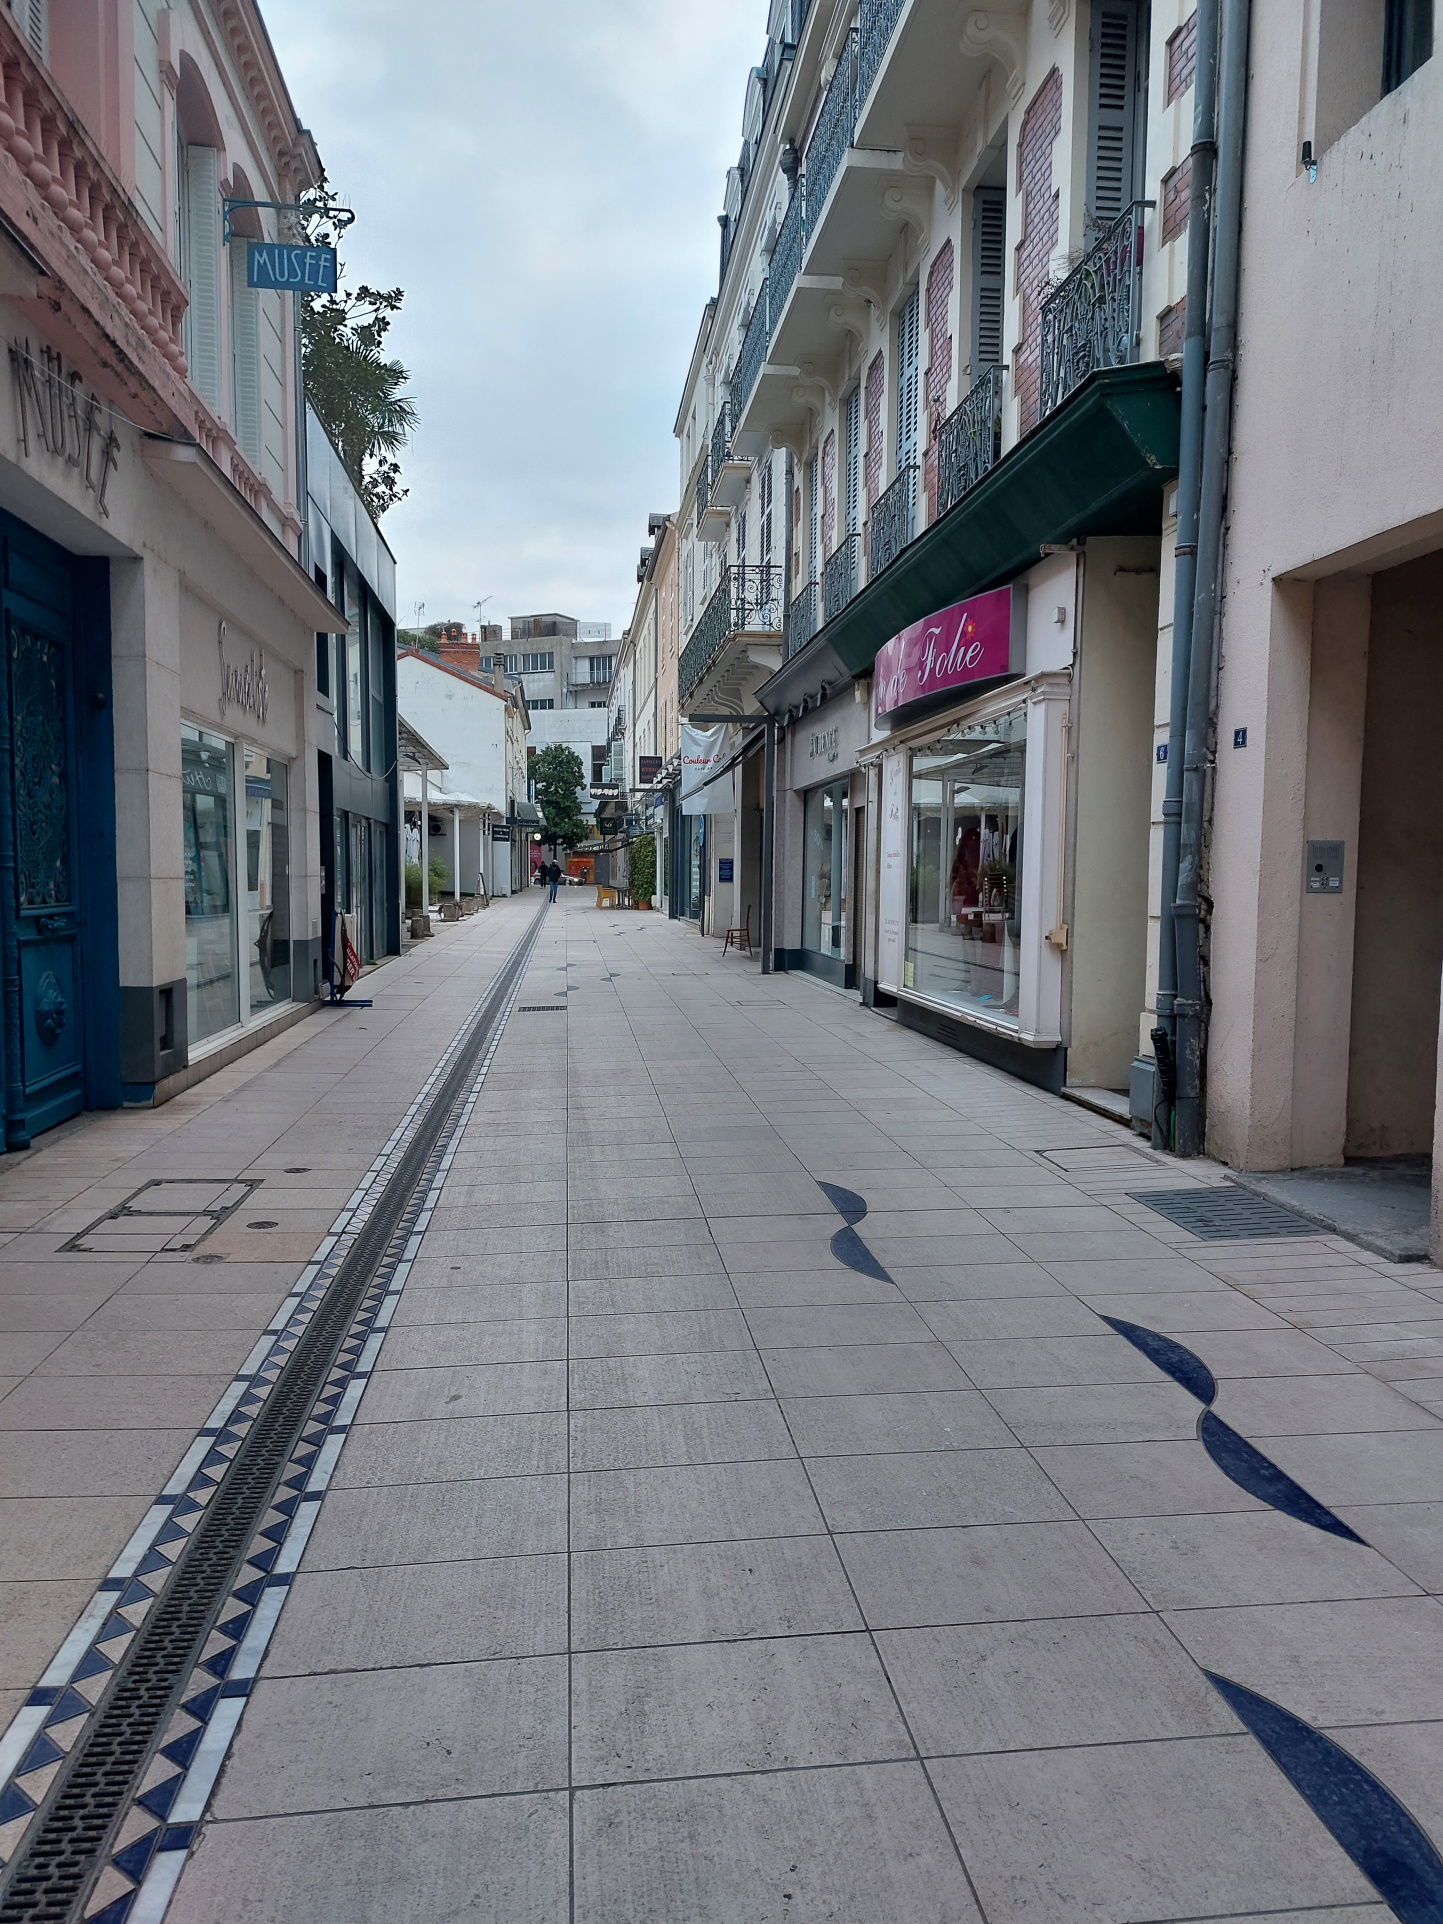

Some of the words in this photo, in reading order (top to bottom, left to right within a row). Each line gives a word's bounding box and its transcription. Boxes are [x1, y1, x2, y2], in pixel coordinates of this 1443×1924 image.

[253, 249, 331, 287] MUSEE
[13, 336, 121, 519] MUSEE
[917, 612, 985, 686] Folie
[1237, 730, 1243, 745] 4
[682, 754, 712, 765] Couleur
[1159, 747, 1165, 760] 6
